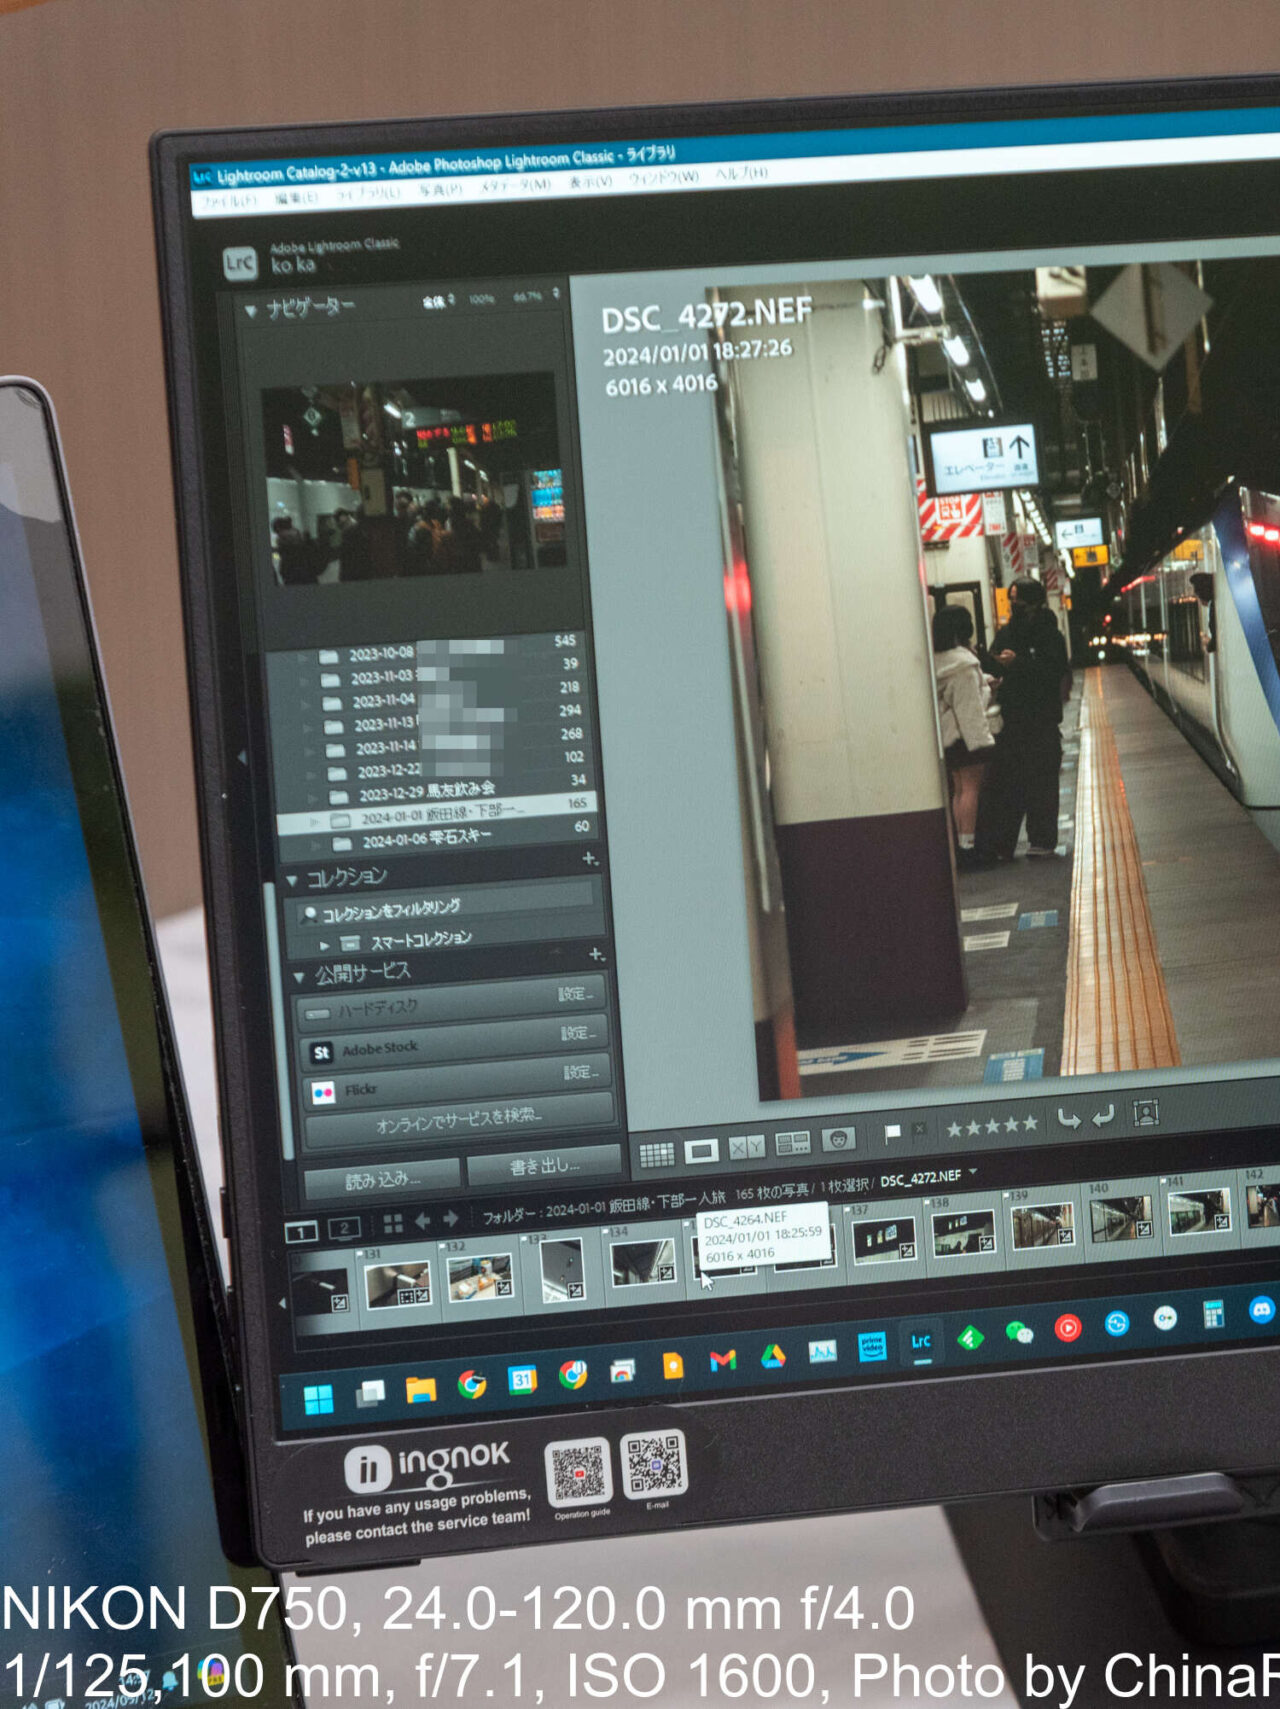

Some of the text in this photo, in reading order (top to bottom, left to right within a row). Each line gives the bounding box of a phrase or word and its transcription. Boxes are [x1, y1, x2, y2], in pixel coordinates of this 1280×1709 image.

[217, 145, 677, 188] Lightroom Catalog-2-v13 Adobe Photoshop Lightroom Classic ライブラリ
[270, 236, 400, 256] Adobe Lightroom Classic
[271, 255, 317, 273] ko ka
[267, 297, 356, 320] ナビゲーター
[602, 296, 813, 334] DSC_4272.NEF
[603, 338, 793, 367] 2024/01/01 18:27:26
[606, 373, 719, 396] 6016 x 4016
[555, 634, 577, 648] 545
[350, 645, 414, 662] 2023-10-08
[563, 657, 579, 670] 39
[351, 669, 413, 686] 2023-11-03
[560, 681, 580, 694] 218
[353, 692, 416, 709] 2023-11-04
[559, 704, 582, 717] 294
[354, 716, 414, 733] 2023-11-13
[560, 728, 583, 741] 268
[356, 740, 417, 756] 2023-11-14
[565, 751, 585, 764] 102
[357, 763, 420, 779] 2023-12-22
[571, 774, 587, 786] 34
[359, 785, 424, 802] 2023-12-29
[568, 797, 588, 809] 165
[361, 809, 423, 826] 2024-01-01
[574, 820, 590, 833] 60
[362, 833, 428, 849] 2024-01-06
[307, 867, 388, 889] コレクション
[322, 898, 461, 924] コレクションをフィルタリング
[371, 930, 473, 951] スマートコレクション
[315, 961, 413, 986] 公開サービス
[314, 1045, 330, 1060] St
[342, 1039, 419, 1057] Adobe Stock
[345, 1082, 379, 1097] Flickr
[1167, 1175, 1184, 1187] 141
[1245, 1168, 1264, 1180] 142
[1009, 1190, 1029, 1201] 139
[1089, 1182, 1109, 1194] 140
[484, 1206, 537, 1226] フォルダー
[547, 1200, 607, 1218] 2024-01-01
[736, 1188, 754, 1201] 165
[757, 1183, 810, 1200] 枚の写真
[828, 1177, 870, 1194] 枚選択
[880, 1168, 962, 1189] DSC_4272.NEF
[930, 1197, 950, 1209] 138
[851, 1204, 869, 1216] 137
[704, 1210, 788, 1230] DSC_4264.NEF
[609, 1226, 629, 1238] 134
[705, 1226, 823, 1247] 2024/01/01 18:25:59
[364, 1248, 381, 1260] 131
[706, 1247, 775, 1263] 6016 4016
[515, 1372, 531, 1387] 31
[303, 1489, 531, 1525] If you have any usage problems,
[554, 1507, 611, 1521] Operation guide
[646, 1501, 669, 1511] E-mail
[305, 1508, 531, 1548] please contact the service team!
